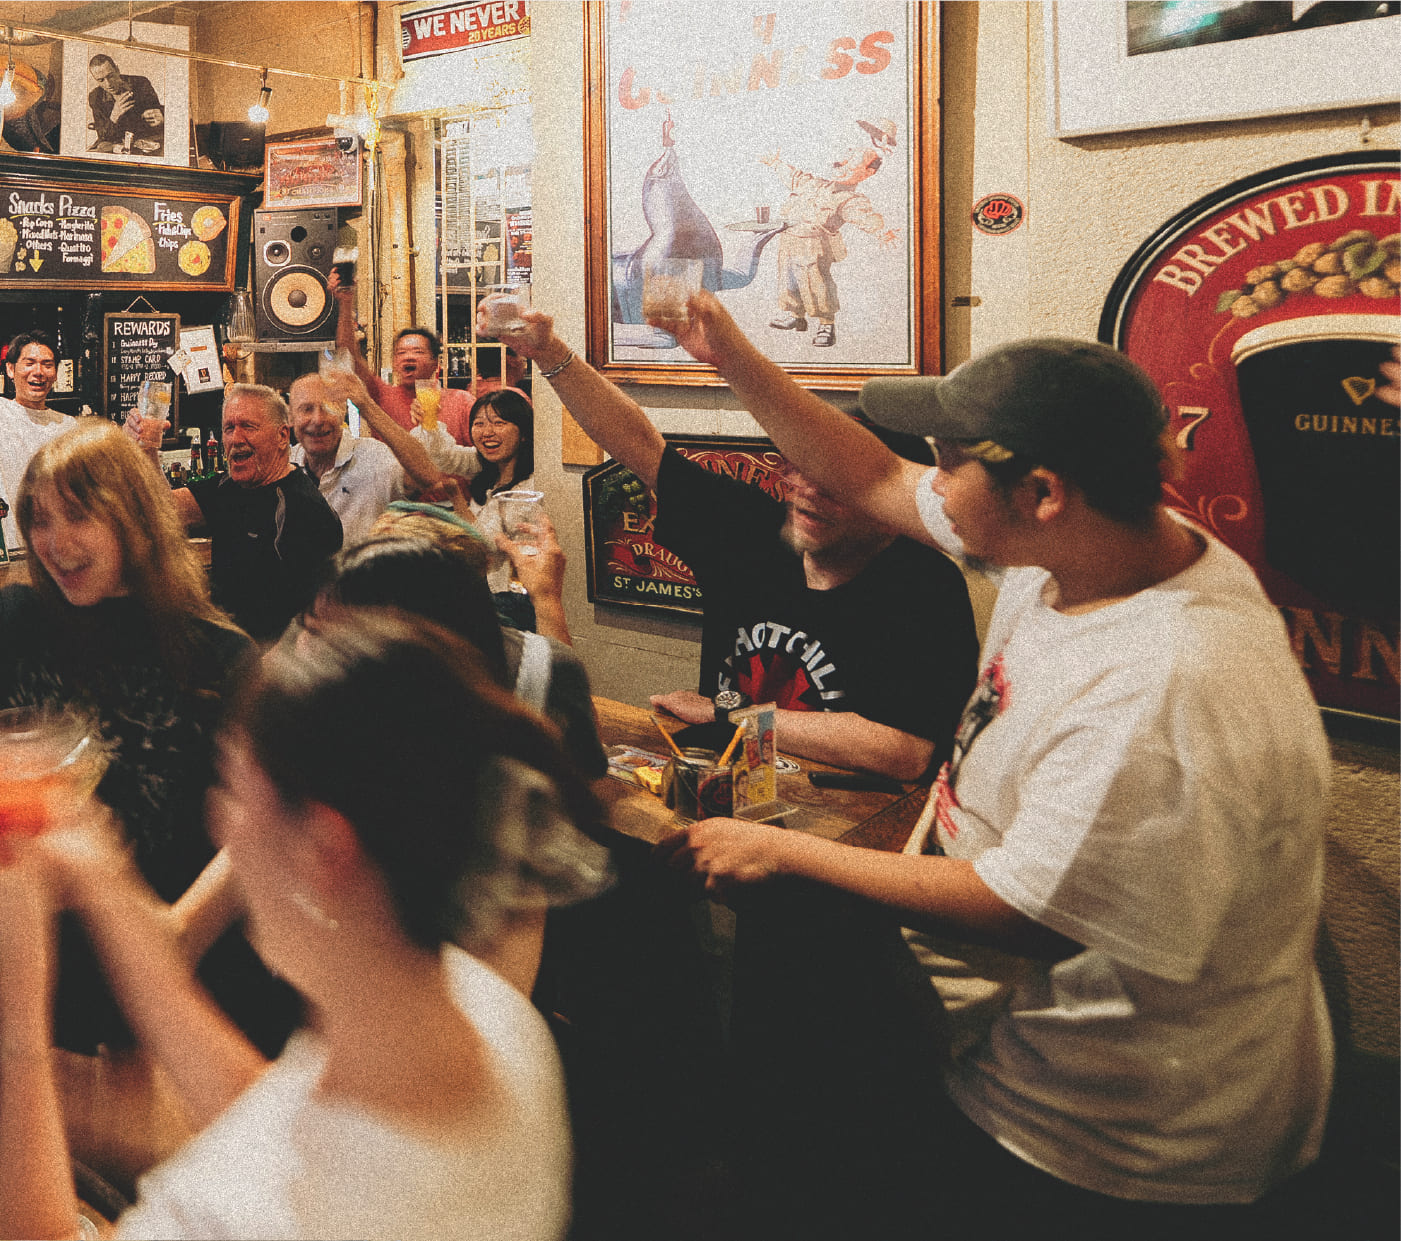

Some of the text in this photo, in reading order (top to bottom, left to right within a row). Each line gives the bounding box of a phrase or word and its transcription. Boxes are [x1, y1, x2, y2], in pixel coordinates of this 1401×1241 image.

[413, 0, 520, 40] WE NEVER
[468, 22, 517, 43] 20 YEARS
[8, 191, 55, 215] Snacks
[59, 194, 97, 218] Pizza
[153, 201, 184, 224] Fries
[1153, 182, 1351, 298] BREWED
[113, 320, 171, 336] REWARDS
[120, 372, 141, 383] HAPPY
[1294, 413, 1401, 436] GUINNE
[632, 542, 694, 577] DRAUG
[636, 580, 703, 600] JAMES'S
[735, 620, 792, 657] HOT
